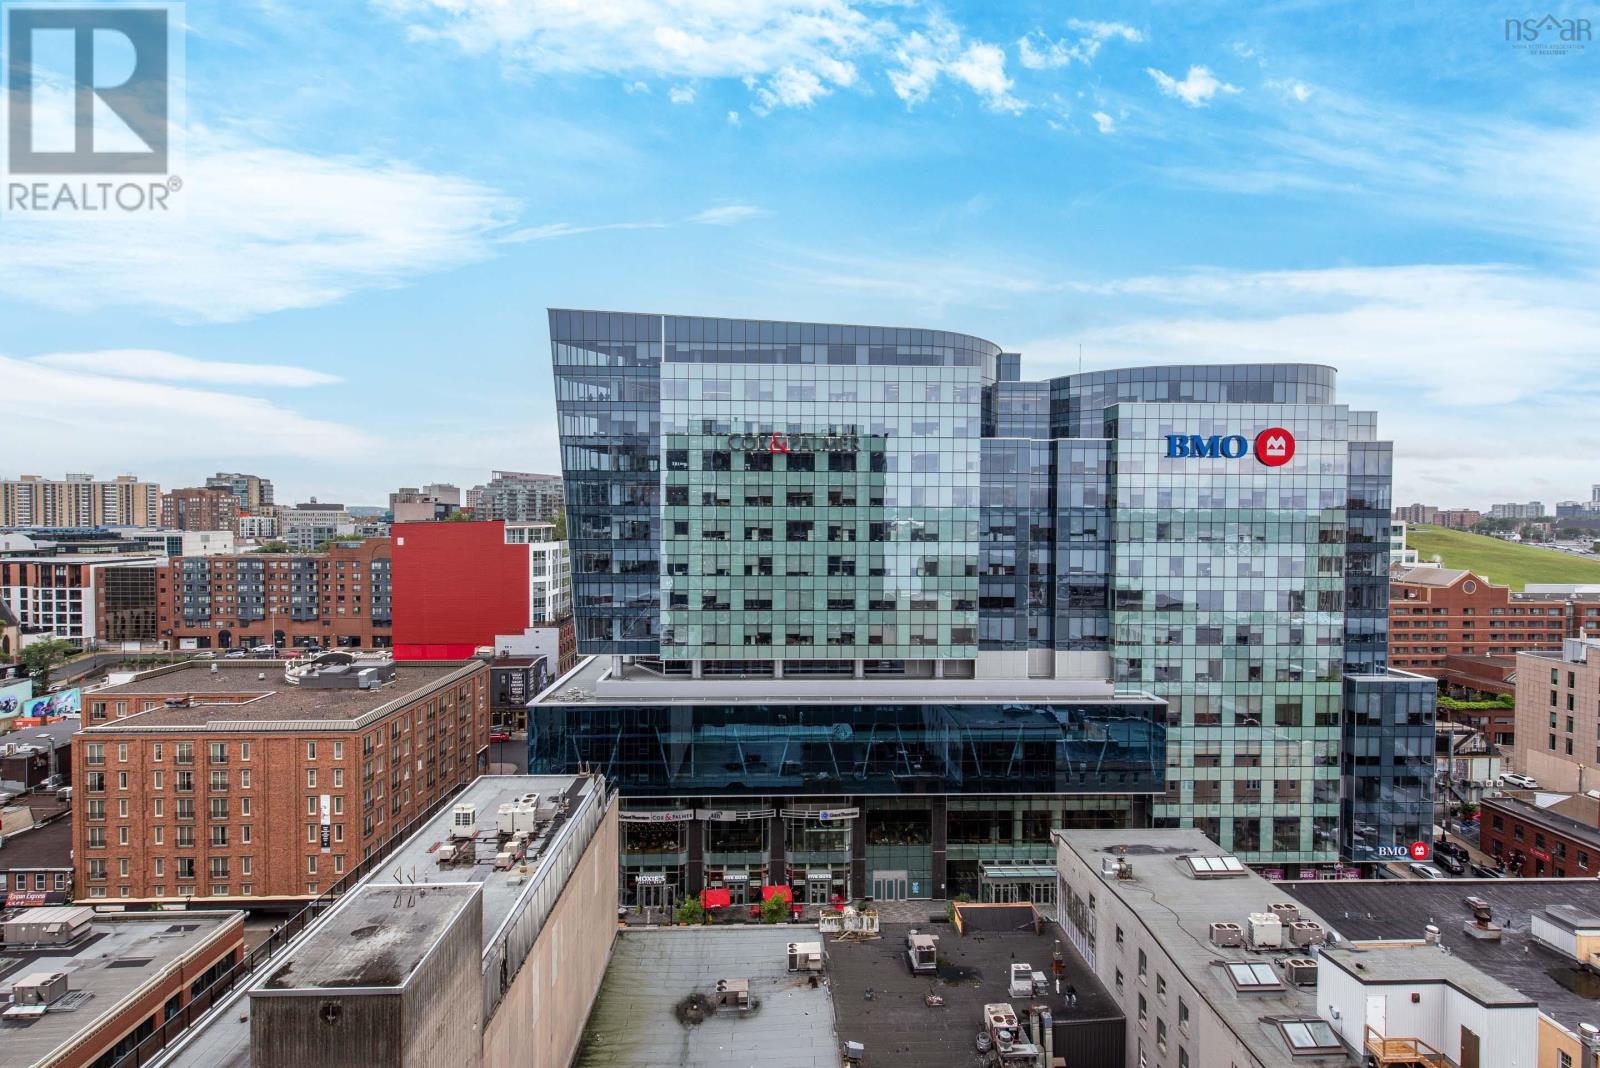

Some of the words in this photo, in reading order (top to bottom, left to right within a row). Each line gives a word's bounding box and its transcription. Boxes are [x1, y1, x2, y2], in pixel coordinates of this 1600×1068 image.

[770, 432, 789, 454] &
[1164, 434, 1248, 459] BMO
[1378, 846, 1408, 856] BMO
